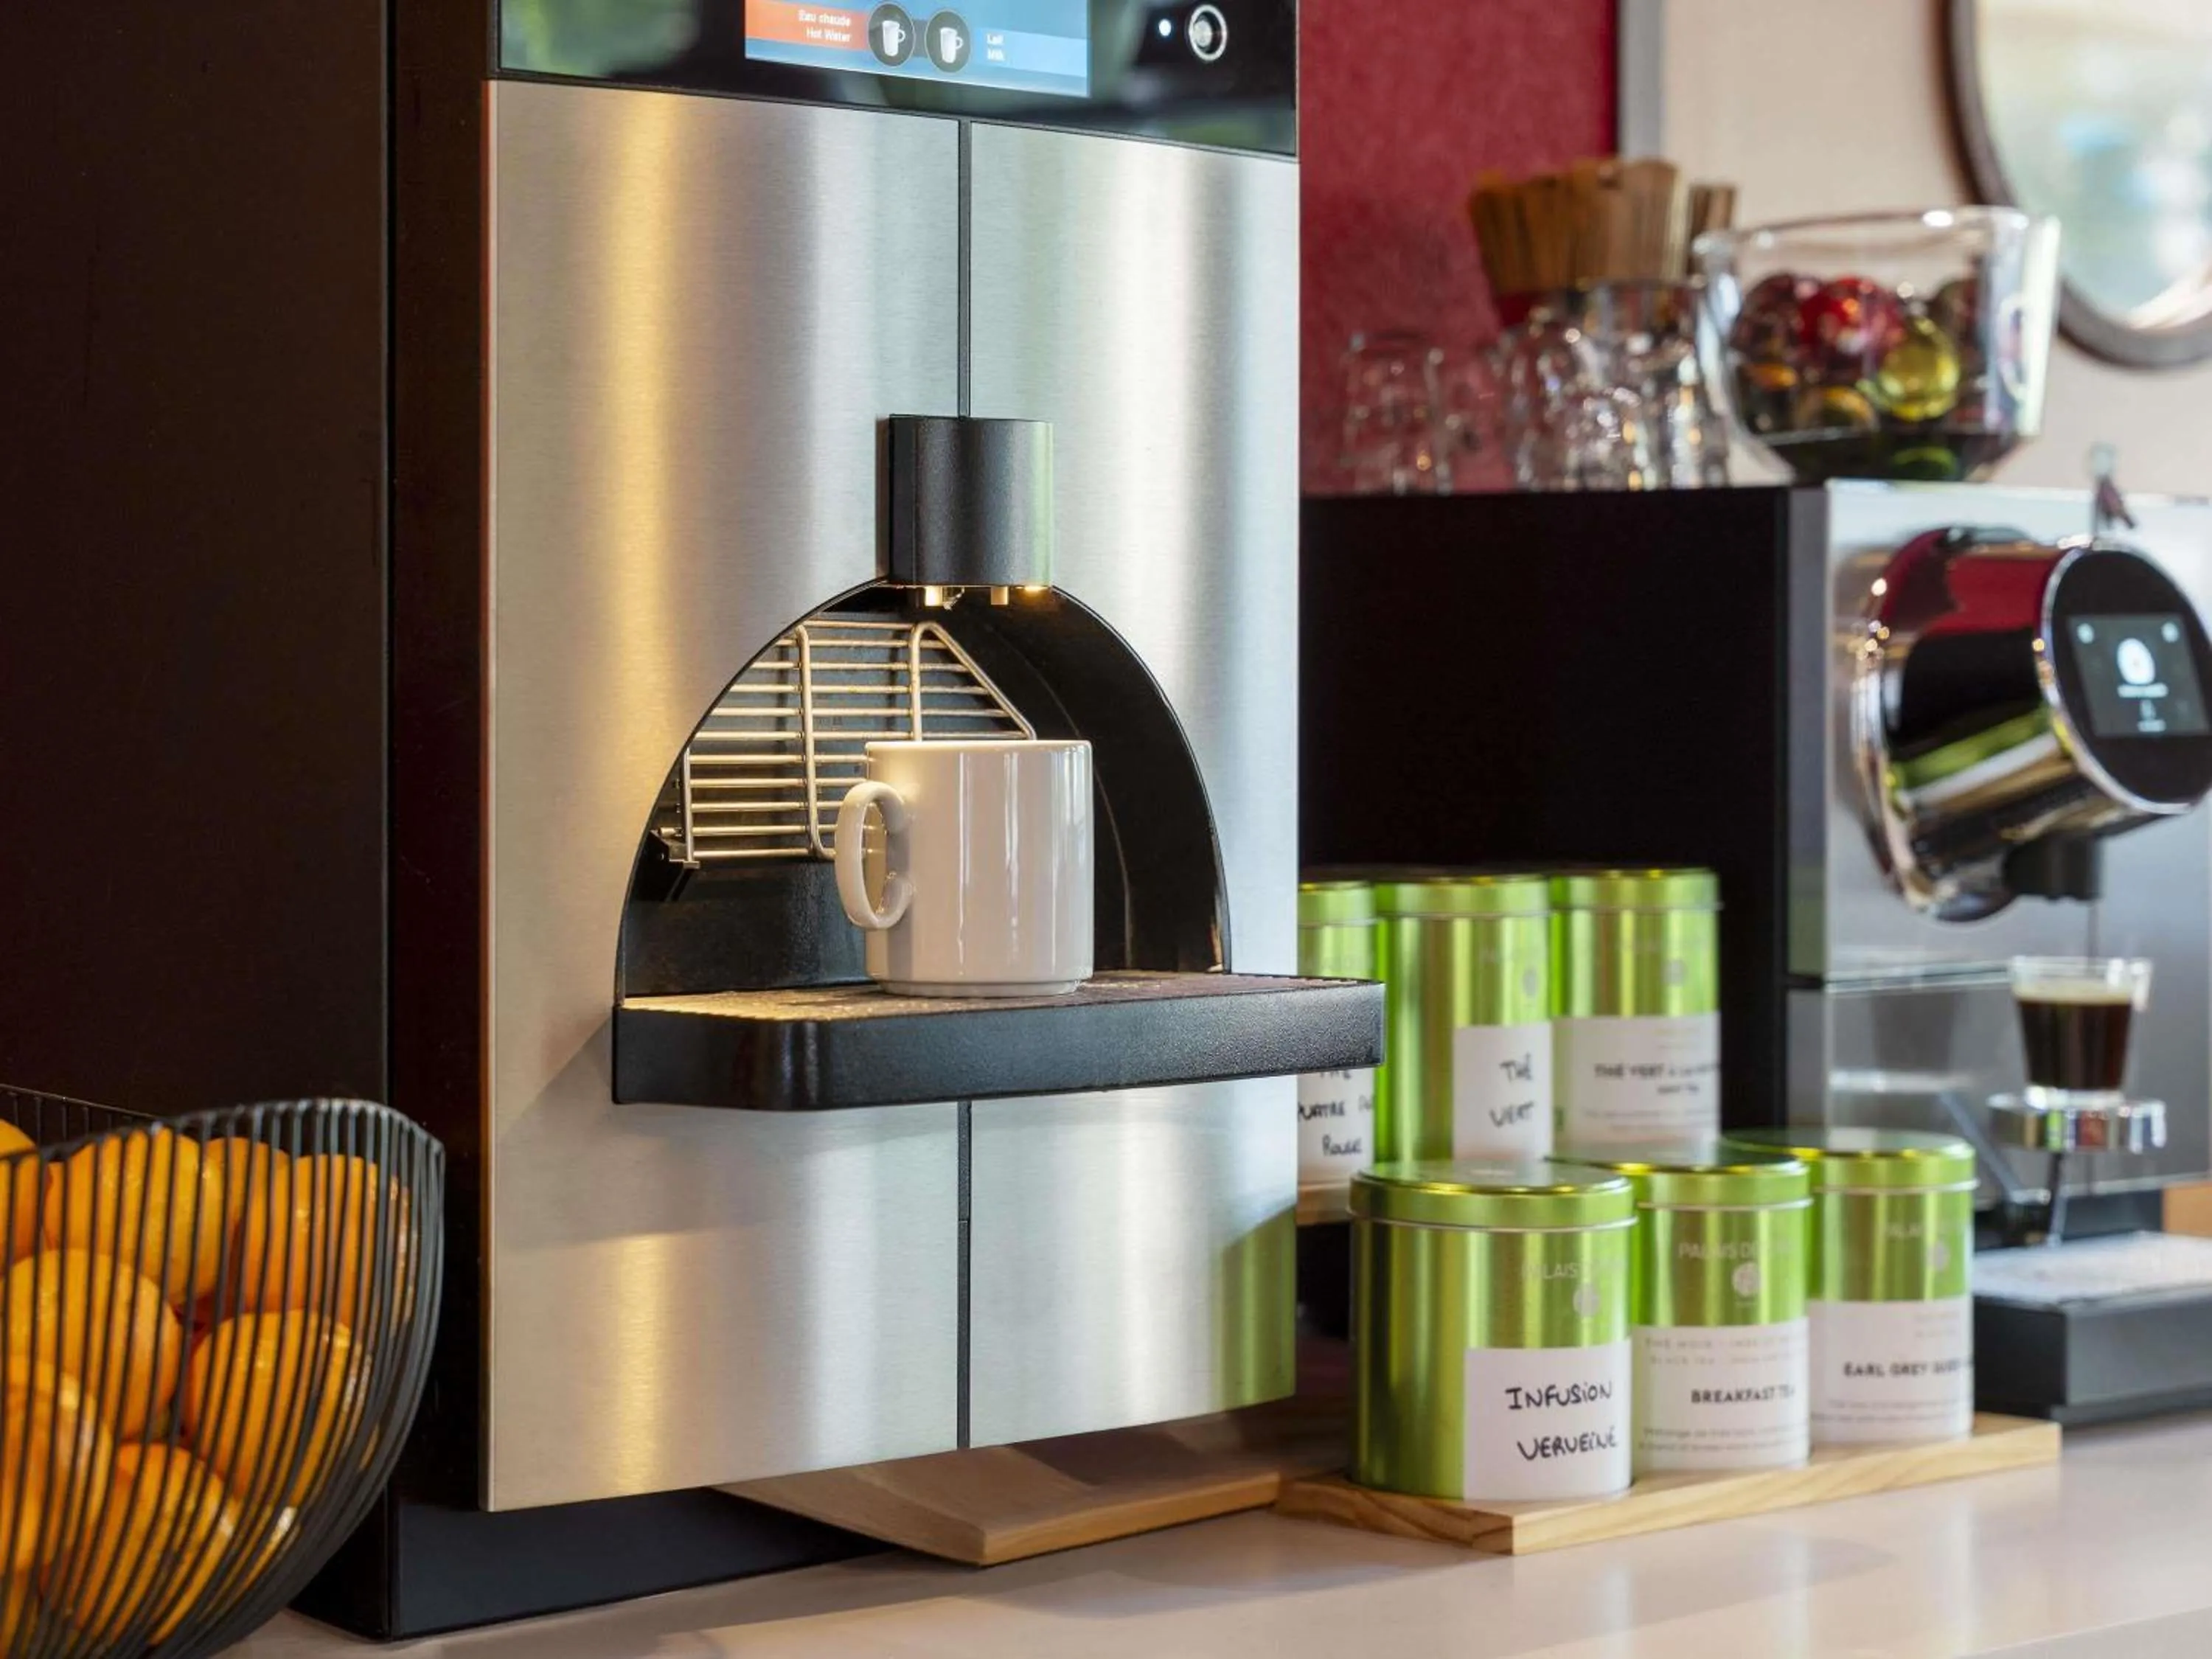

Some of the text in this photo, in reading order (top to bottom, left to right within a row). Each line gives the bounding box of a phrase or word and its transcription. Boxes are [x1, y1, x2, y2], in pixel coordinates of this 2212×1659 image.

[818, 12, 851, 27] chaude
[806, 26, 851, 43] Hot Water
[1489, 1099, 1537, 1128] VERT
[1522, 1262, 1579, 1280] LAIS
[1843, 1362, 1885, 1377] EARL
[1690, 1386, 1775, 1404] BREAKFAST
